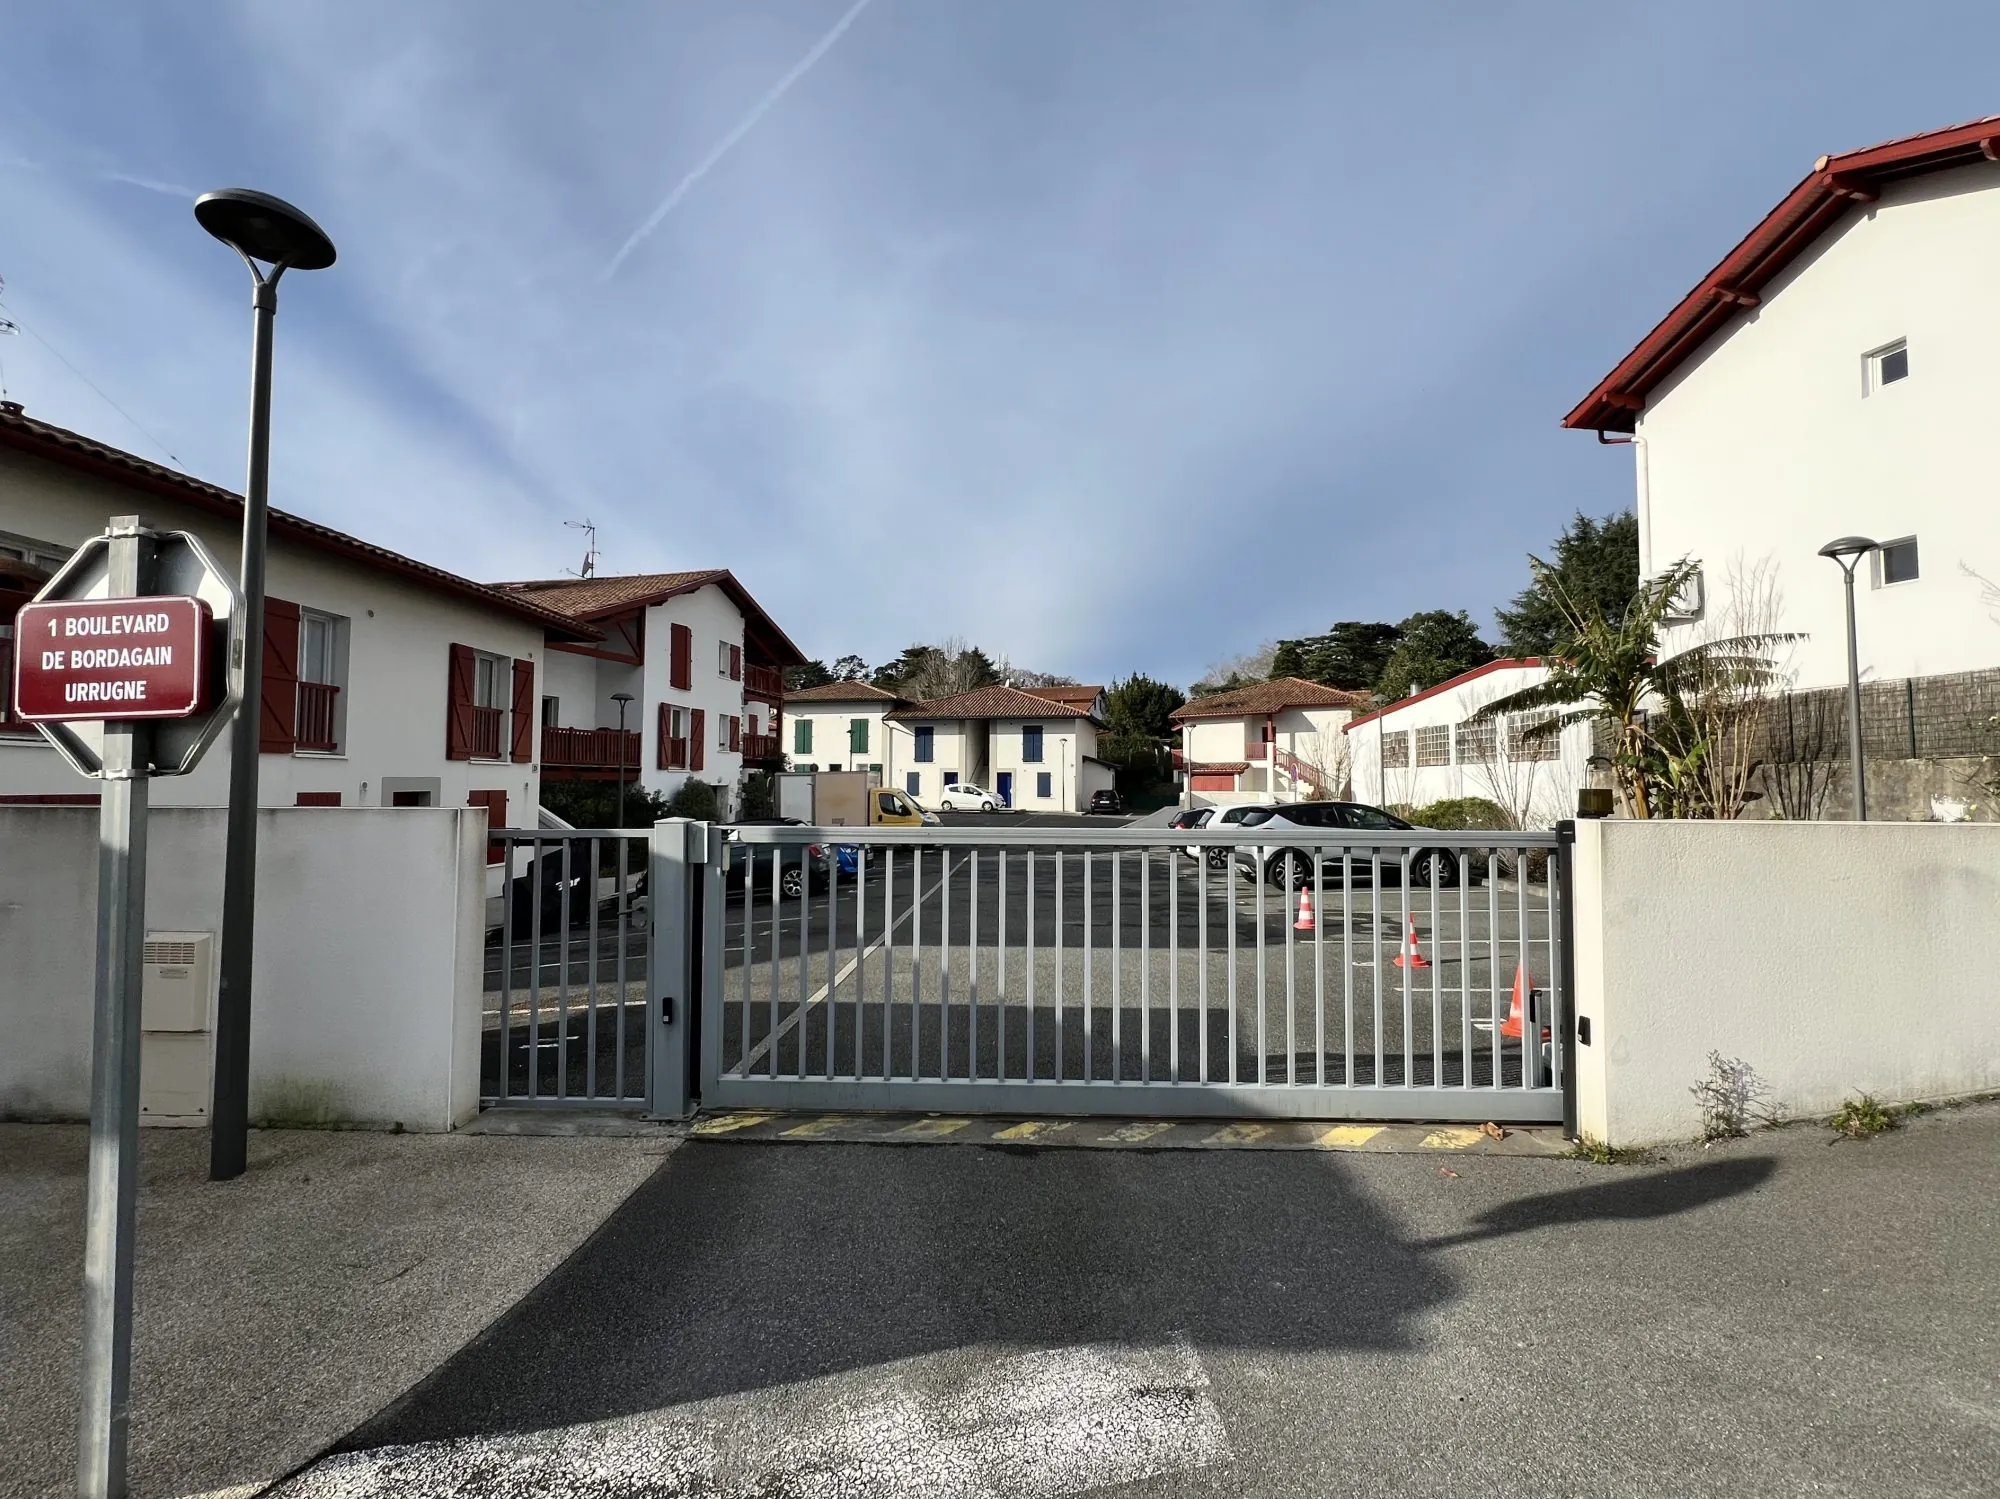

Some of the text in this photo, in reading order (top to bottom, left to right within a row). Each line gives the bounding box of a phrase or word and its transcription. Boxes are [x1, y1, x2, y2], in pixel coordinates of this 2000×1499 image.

[47, 613, 169, 637] 1 BOULEVARD
[41, 646, 172, 670] DE BORDAGAIN
[65, 680, 147, 702] URRUGNE
